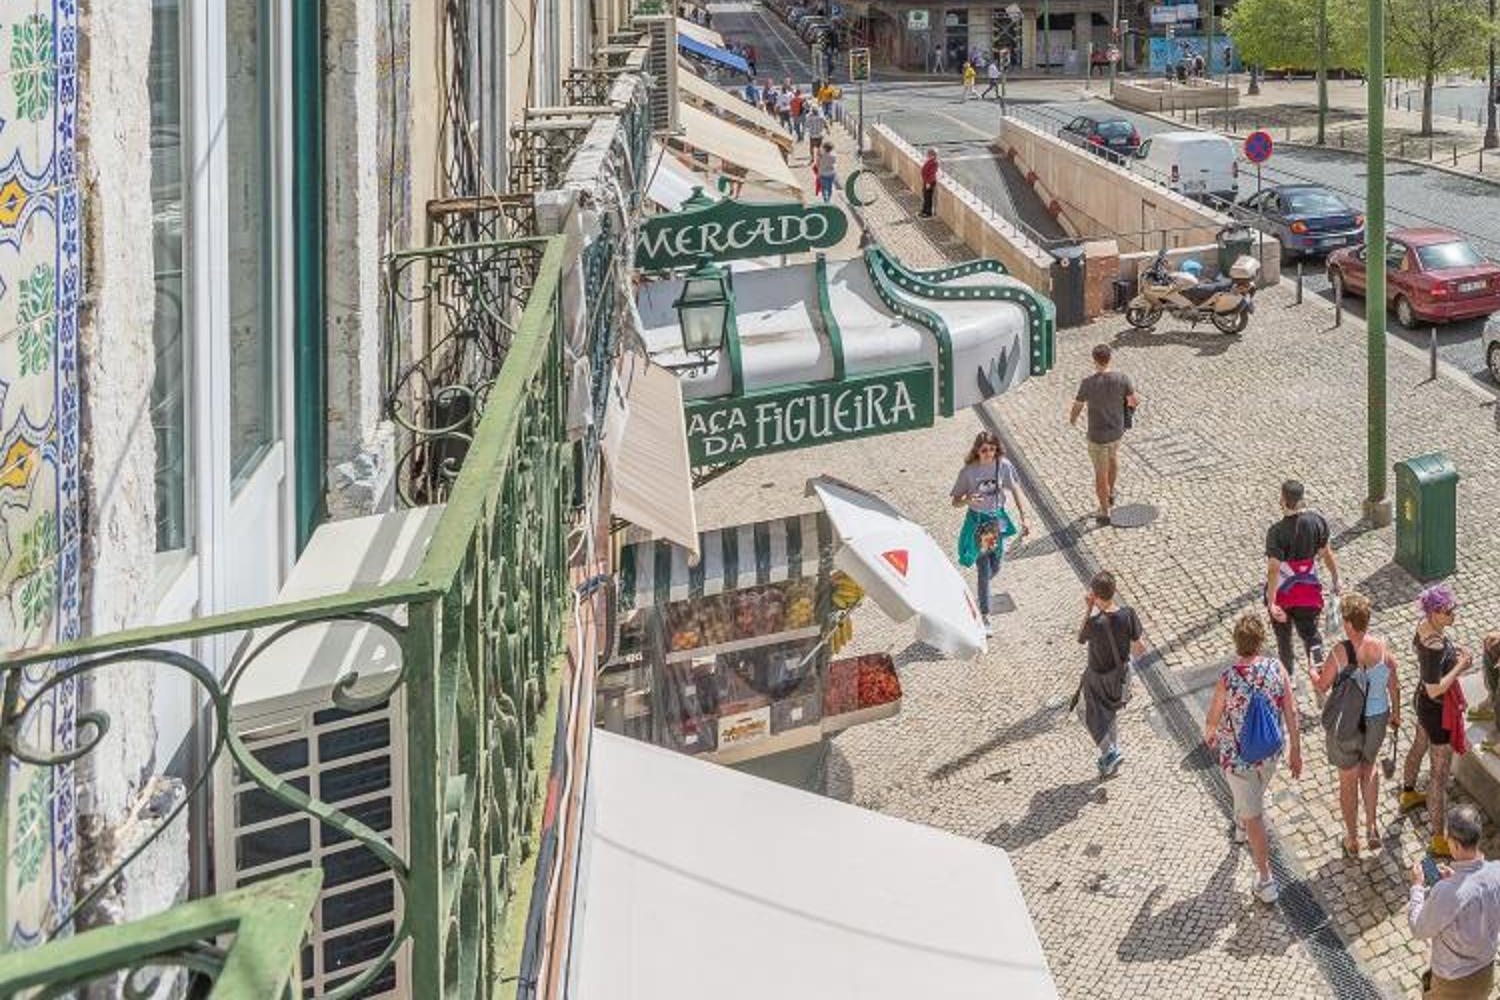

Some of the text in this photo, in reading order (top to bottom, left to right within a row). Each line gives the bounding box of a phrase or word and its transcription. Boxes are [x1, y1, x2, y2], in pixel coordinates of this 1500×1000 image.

[635, 213, 829, 258] MERCADO
[688, 407, 747, 437] AÇA
[705, 433, 747, 456] DA
